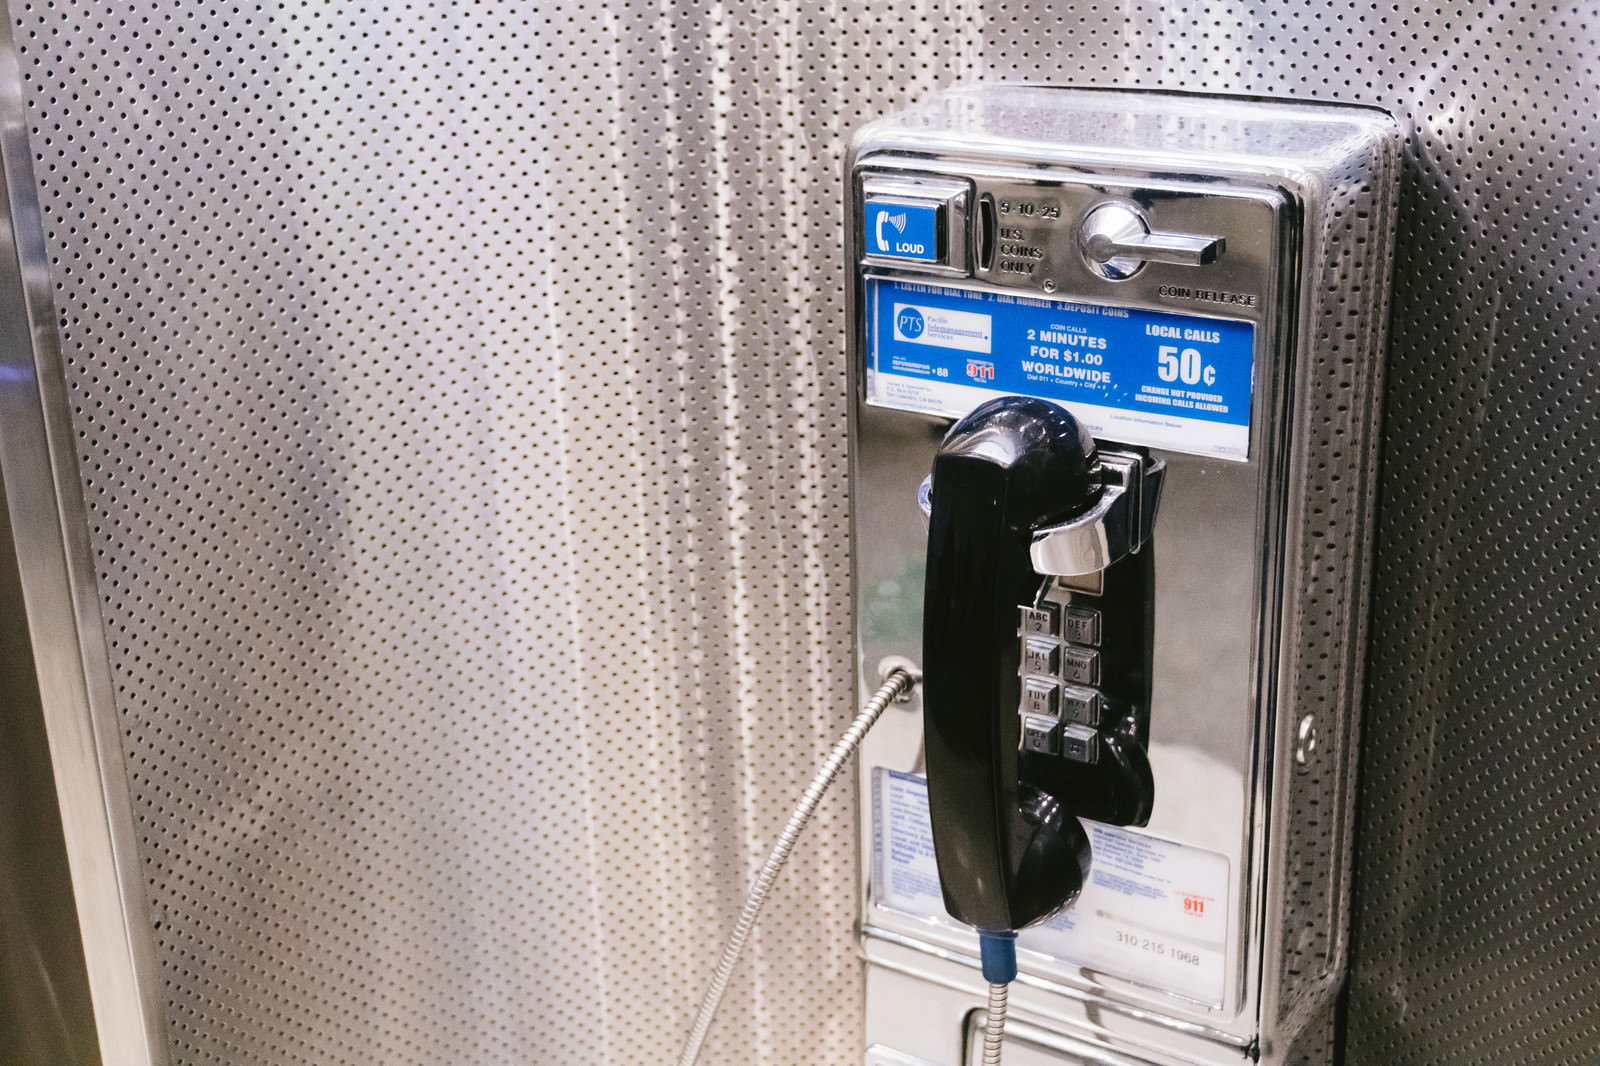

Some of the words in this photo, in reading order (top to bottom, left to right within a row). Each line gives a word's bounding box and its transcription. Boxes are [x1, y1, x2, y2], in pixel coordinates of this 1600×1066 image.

[896, 242, 924, 254] LOUD
[1000, 243, 1043, 260] COINS
[1000, 260, 1034, 275] ONLY
[901, 282, 926, 293] LISTEN
[927, 285, 943, 296] FOR
[944, 287, 962, 298] DIAL
[963, 289, 983, 300] TONE
[996, 294, 1015, 305] DIAL
[1017, 297, 1052, 309] NUMBER
[1102, 307, 1129, 318] COINS
[1159, 285, 1191, 299] COIN
[1195, 289, 1256, 307] RELEASE
[899, 315, 922, 332] PTS
[1050, 323, 1066, 331] COIN
[1066, 325, 1087, 334] CALLS
[1026, 329, 1036, 340] 2
[1040, 330, 1107, 350] MINUTES
[1145, 324, 1182, 339] LOCAL
[1184, 328, 1220, 343] CALLS
[1030, 345, 1059, 360] FOR
[1063, 349, 1103, 366] $1.00
[966, 364, 994, 380] 911
[1021, 360, 1111, 383] WORLDWIDE
[1157, 345, 1216, 386] 50¢
[1055, 377, 1078, 388] Country
[1141, 385, 1170, 396] CHANGE
[1171, 388, 1185, 398] NOT
[1186, 391, 1223, 403] PROVIDED
[1135, 393, 1171, 406] INCOMING
[1172, 397, 1194, 408] CALLS
[1195, 401, 1229, 413] ALLOWED
[1029, 611, 1048, 622] ABC
[1068, 618, 1088, 630] DEF
[1035, 622, 1042, 632] 2
[1028, 651, 1047, 661] JKL
[1067, 658, 1087, 669] MNO
[1073, 670, 1080, 679] 6
[1028, 690, 1046, 700] TUV
[1183, 898, 1204, 913] 911
[1115, 930, 1138, 946] 310
[1142, 939, 1165, 955] 215
[1170, 948, 1200, 966] 1968
